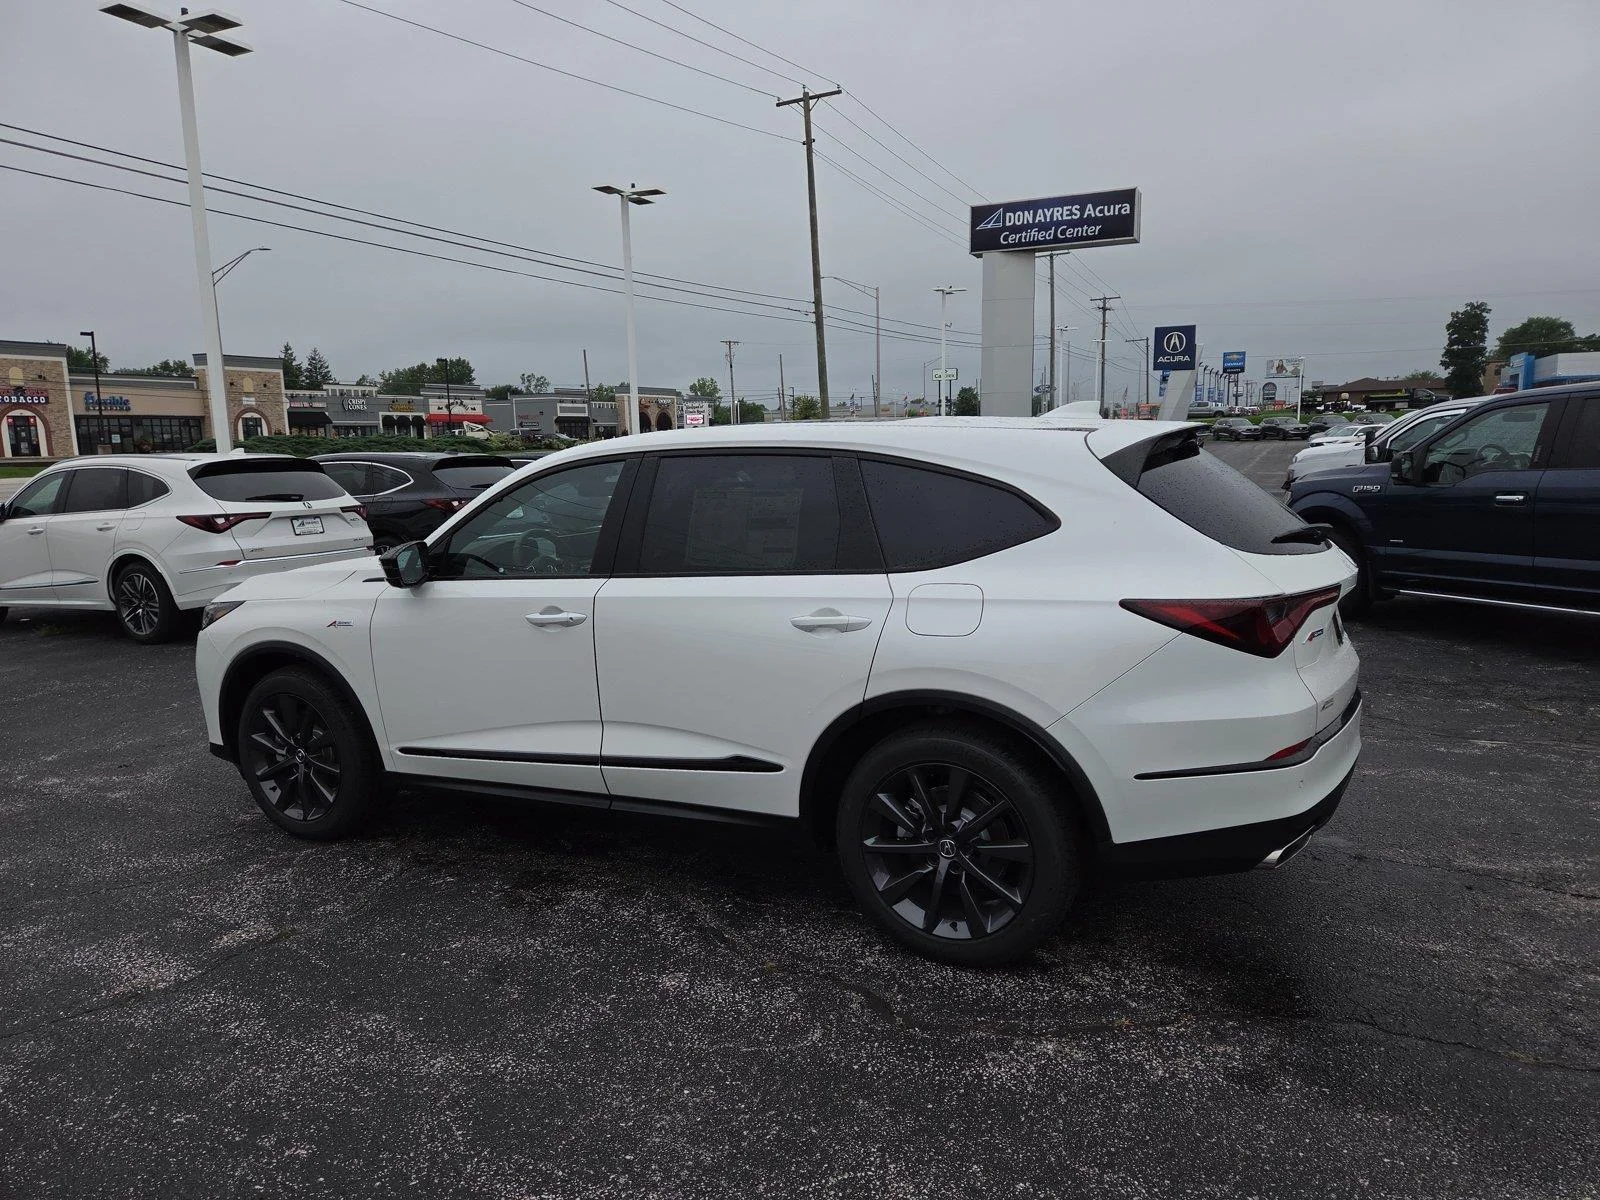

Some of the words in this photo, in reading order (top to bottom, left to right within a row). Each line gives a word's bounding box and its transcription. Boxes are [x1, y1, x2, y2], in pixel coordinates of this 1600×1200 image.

[1005, 209, 1034, 227] DON
[1035, 205, 1081, 223] AYRES
[1084, 203, 1131, 218] Acura
[1000, 226, 1055, 245] Certified
[1057, 224, 1102, 239] Center
[1157, 355, 1191, 363] ACURA
